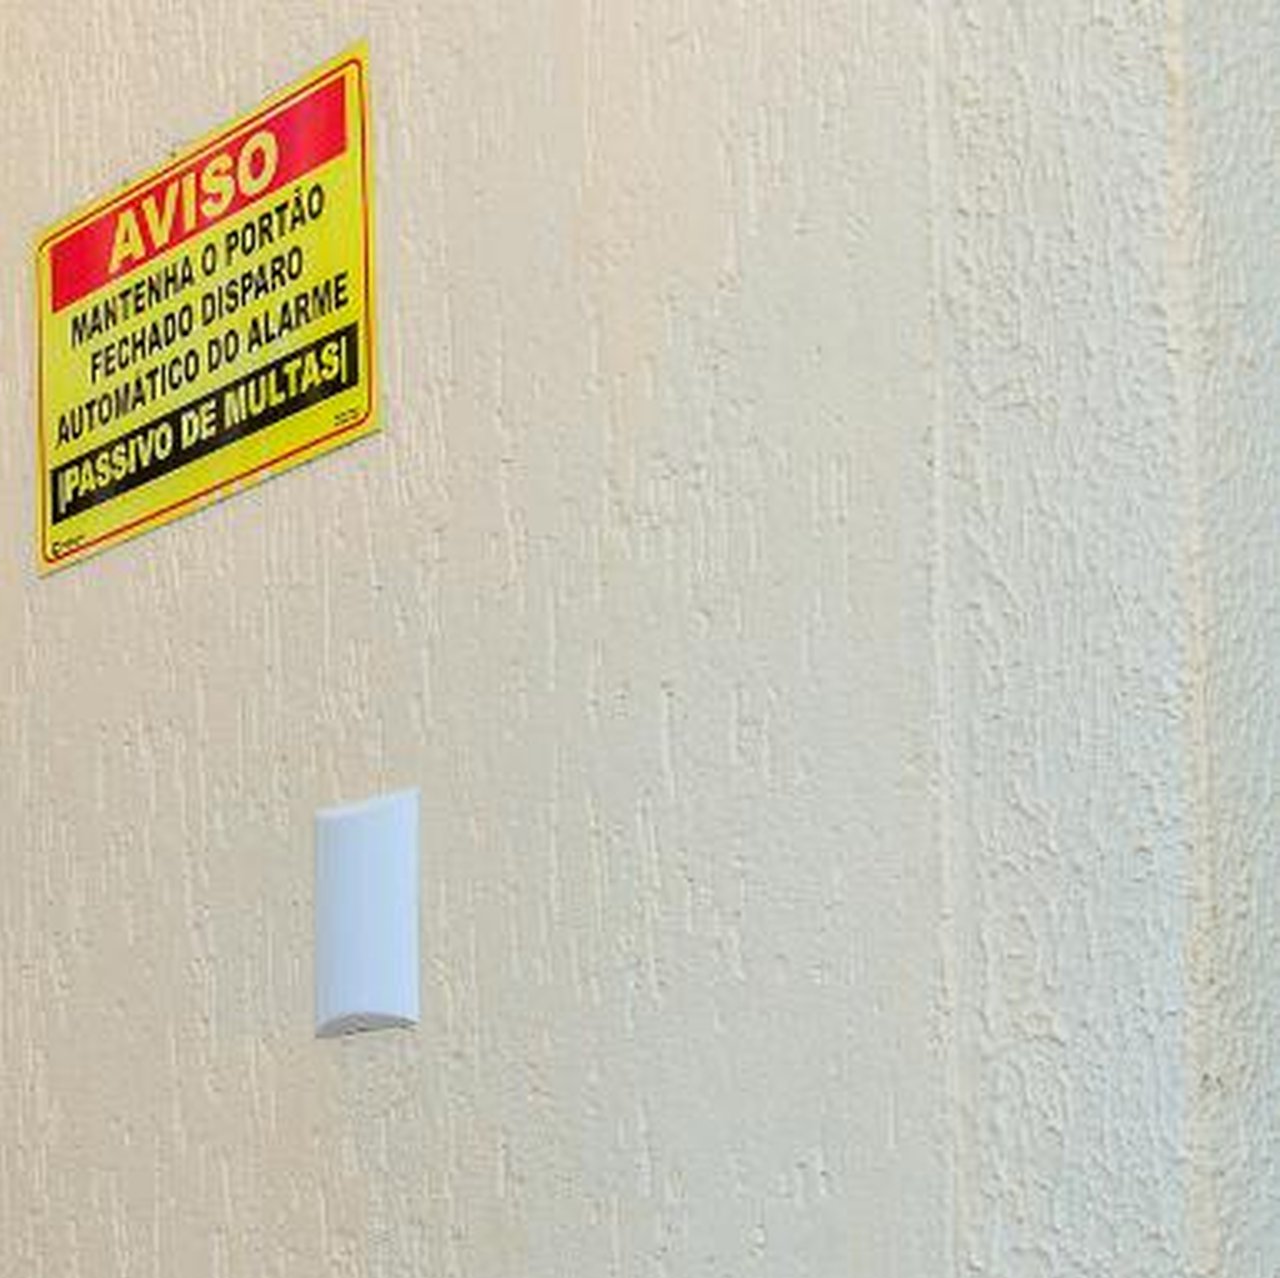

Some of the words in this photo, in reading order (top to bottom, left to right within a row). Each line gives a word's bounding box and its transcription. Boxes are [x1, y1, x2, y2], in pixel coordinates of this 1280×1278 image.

[71, 256, 193, 348] MANTENHA
[201, 242, 217, 277] O
[225, 184, 325, 267] PORTÃO
[108, 131, 278, 274] AVISO
[91, 304, 193, 383] FECHADO
[201, 246, 303, 327] DISPARO
[207, 328, 240, 373] DO
[247, 272, 349, 353] ALARME
[65, 422, 173, 503] PASSIVO
[181, 400, 217, 449] DE
